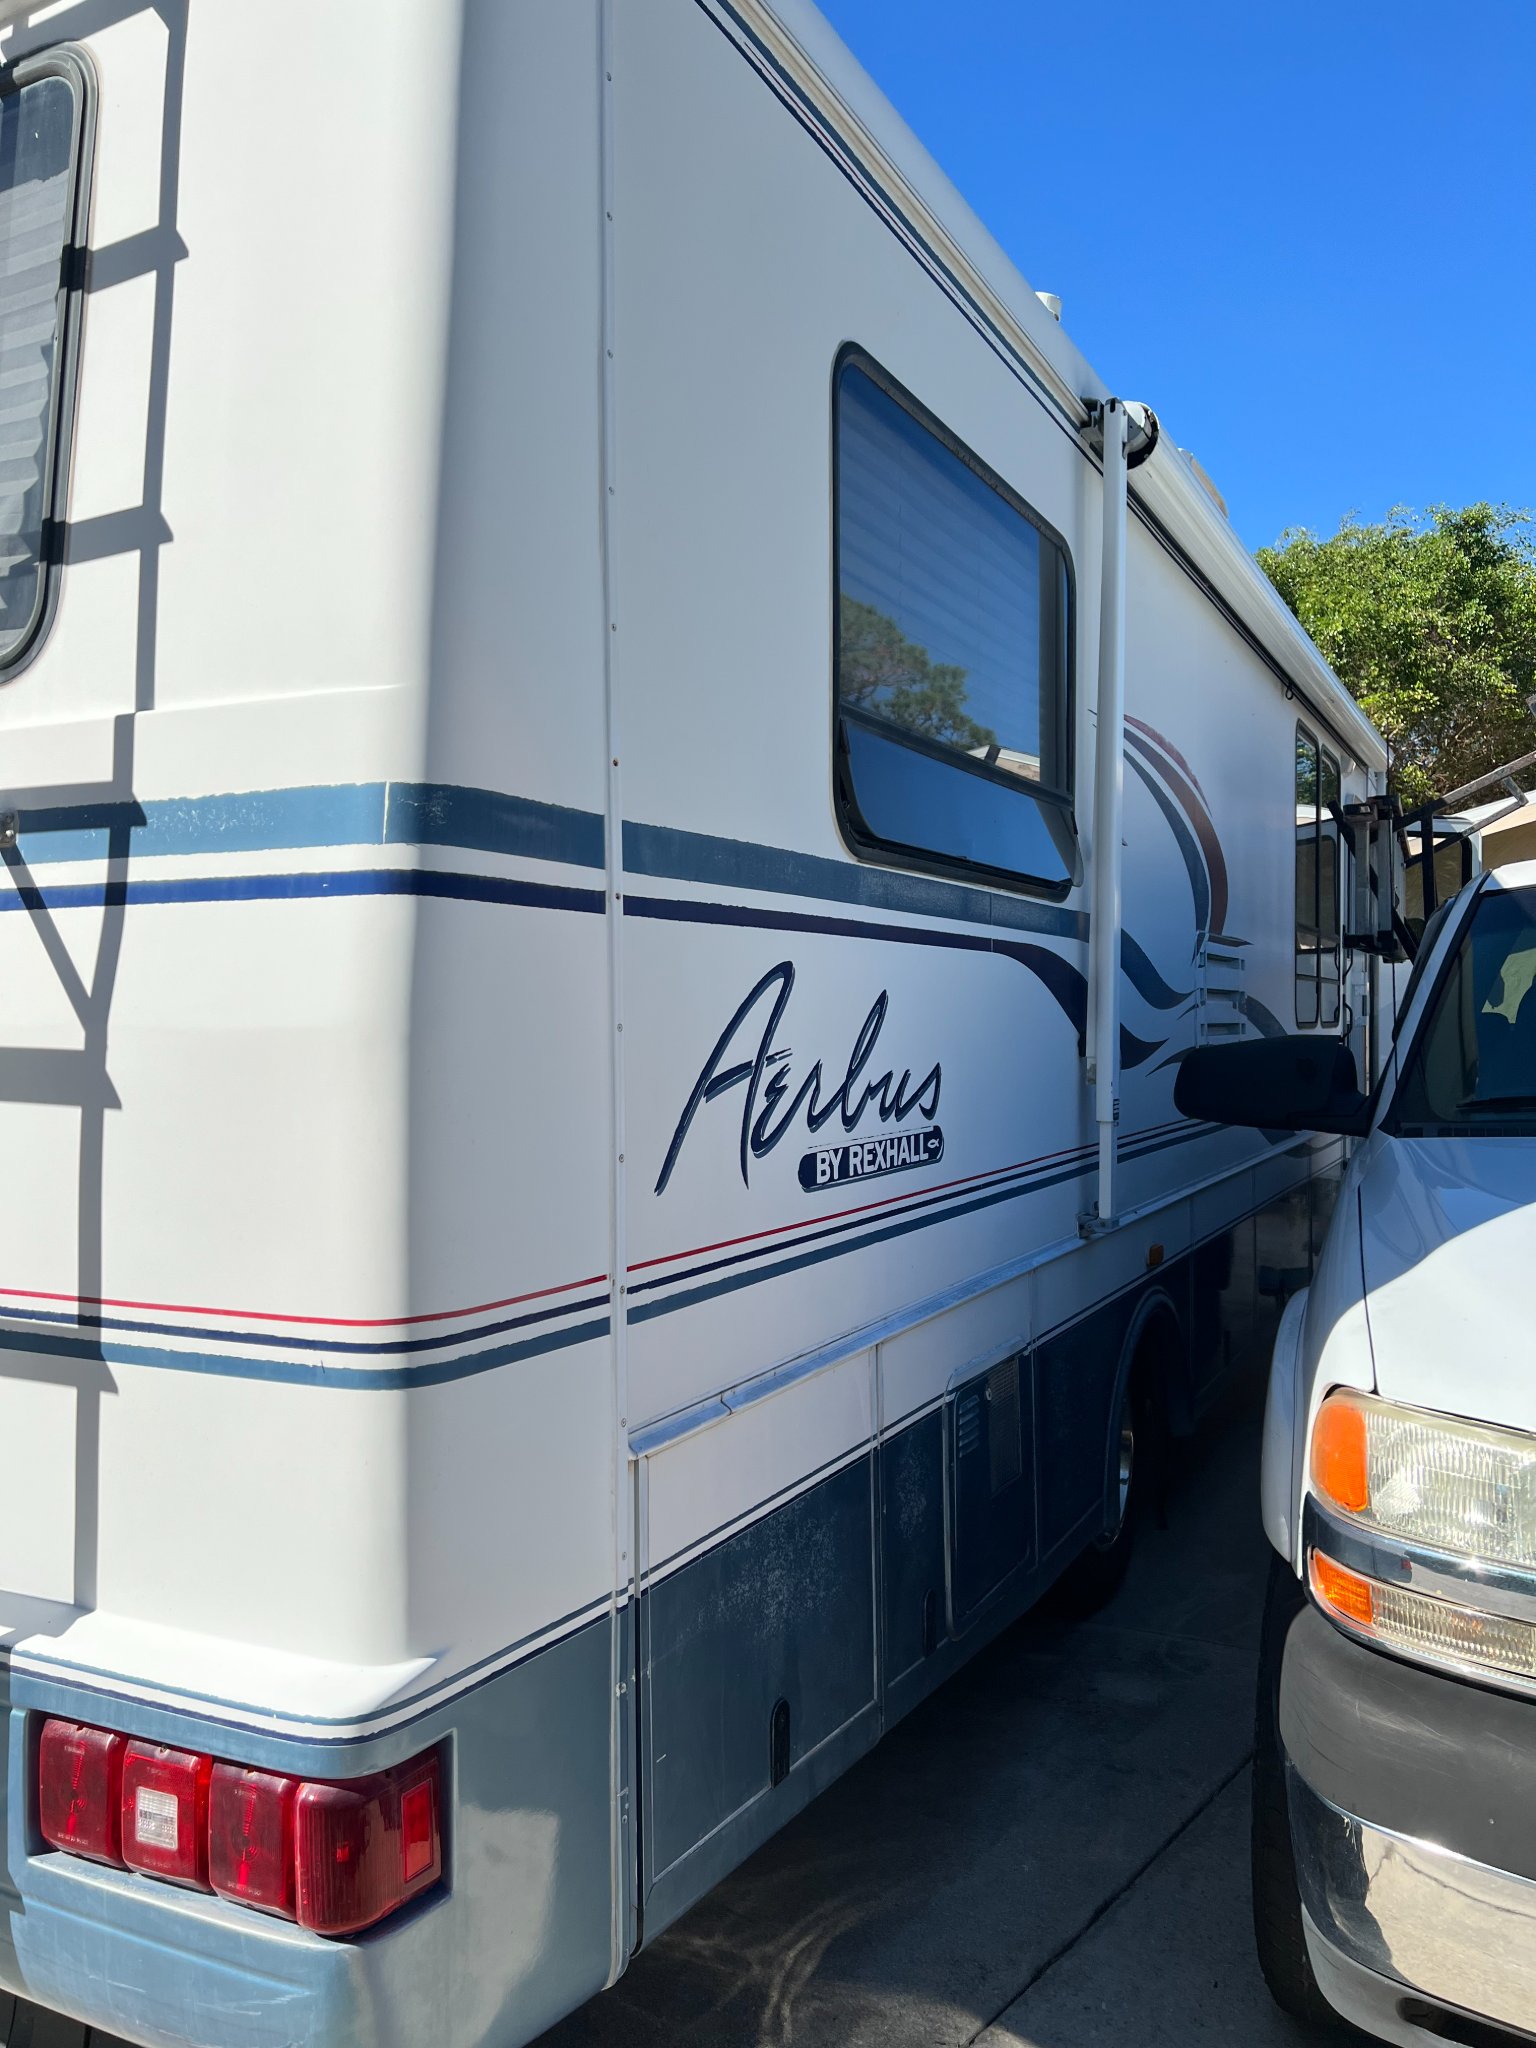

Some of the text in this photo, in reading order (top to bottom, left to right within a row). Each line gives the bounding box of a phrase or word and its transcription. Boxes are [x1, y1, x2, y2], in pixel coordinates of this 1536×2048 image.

[654, 960, 942, 1196] Aerbus
[816, 1133, 929, 1184] BY REXHALL
